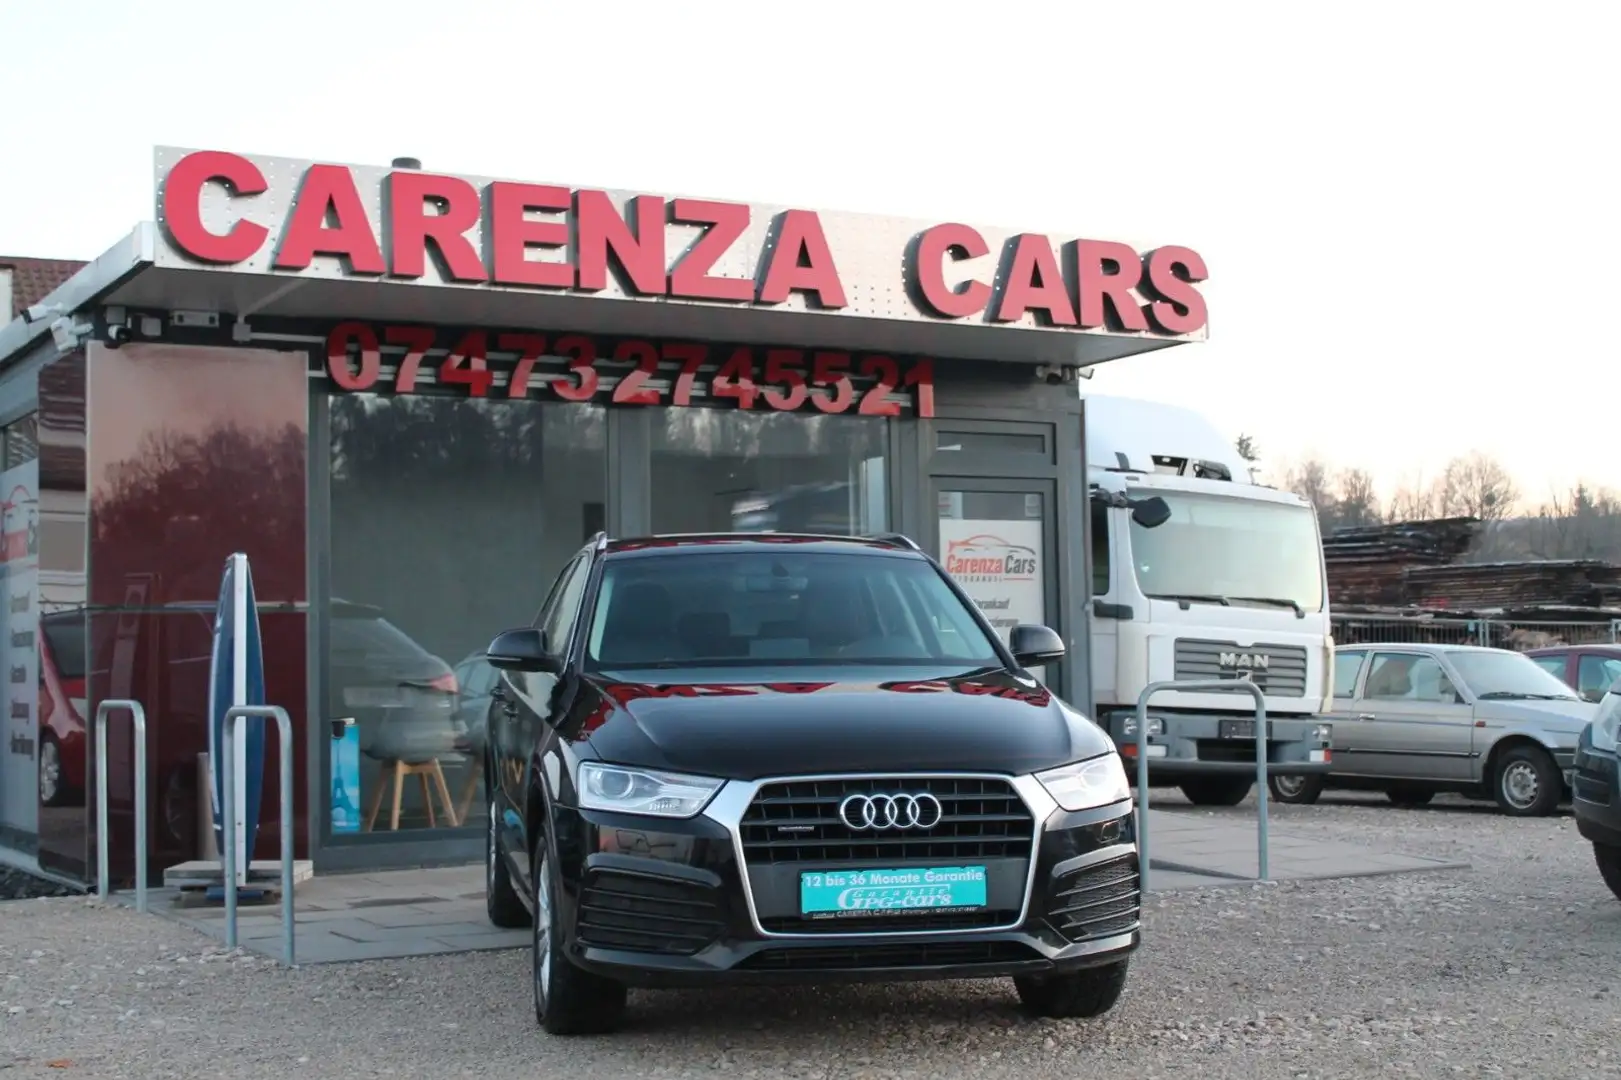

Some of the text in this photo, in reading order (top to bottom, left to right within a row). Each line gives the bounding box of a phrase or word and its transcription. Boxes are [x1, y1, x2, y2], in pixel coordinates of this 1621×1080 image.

[162, 150, 1209, 335] CARENZA CARS
[327, 322, 935, 418] 07473 2745521
[1220, 652, 1269, 668] MAN
[805, 869, 983, 887] 12 bis 36 Monate Garantie
